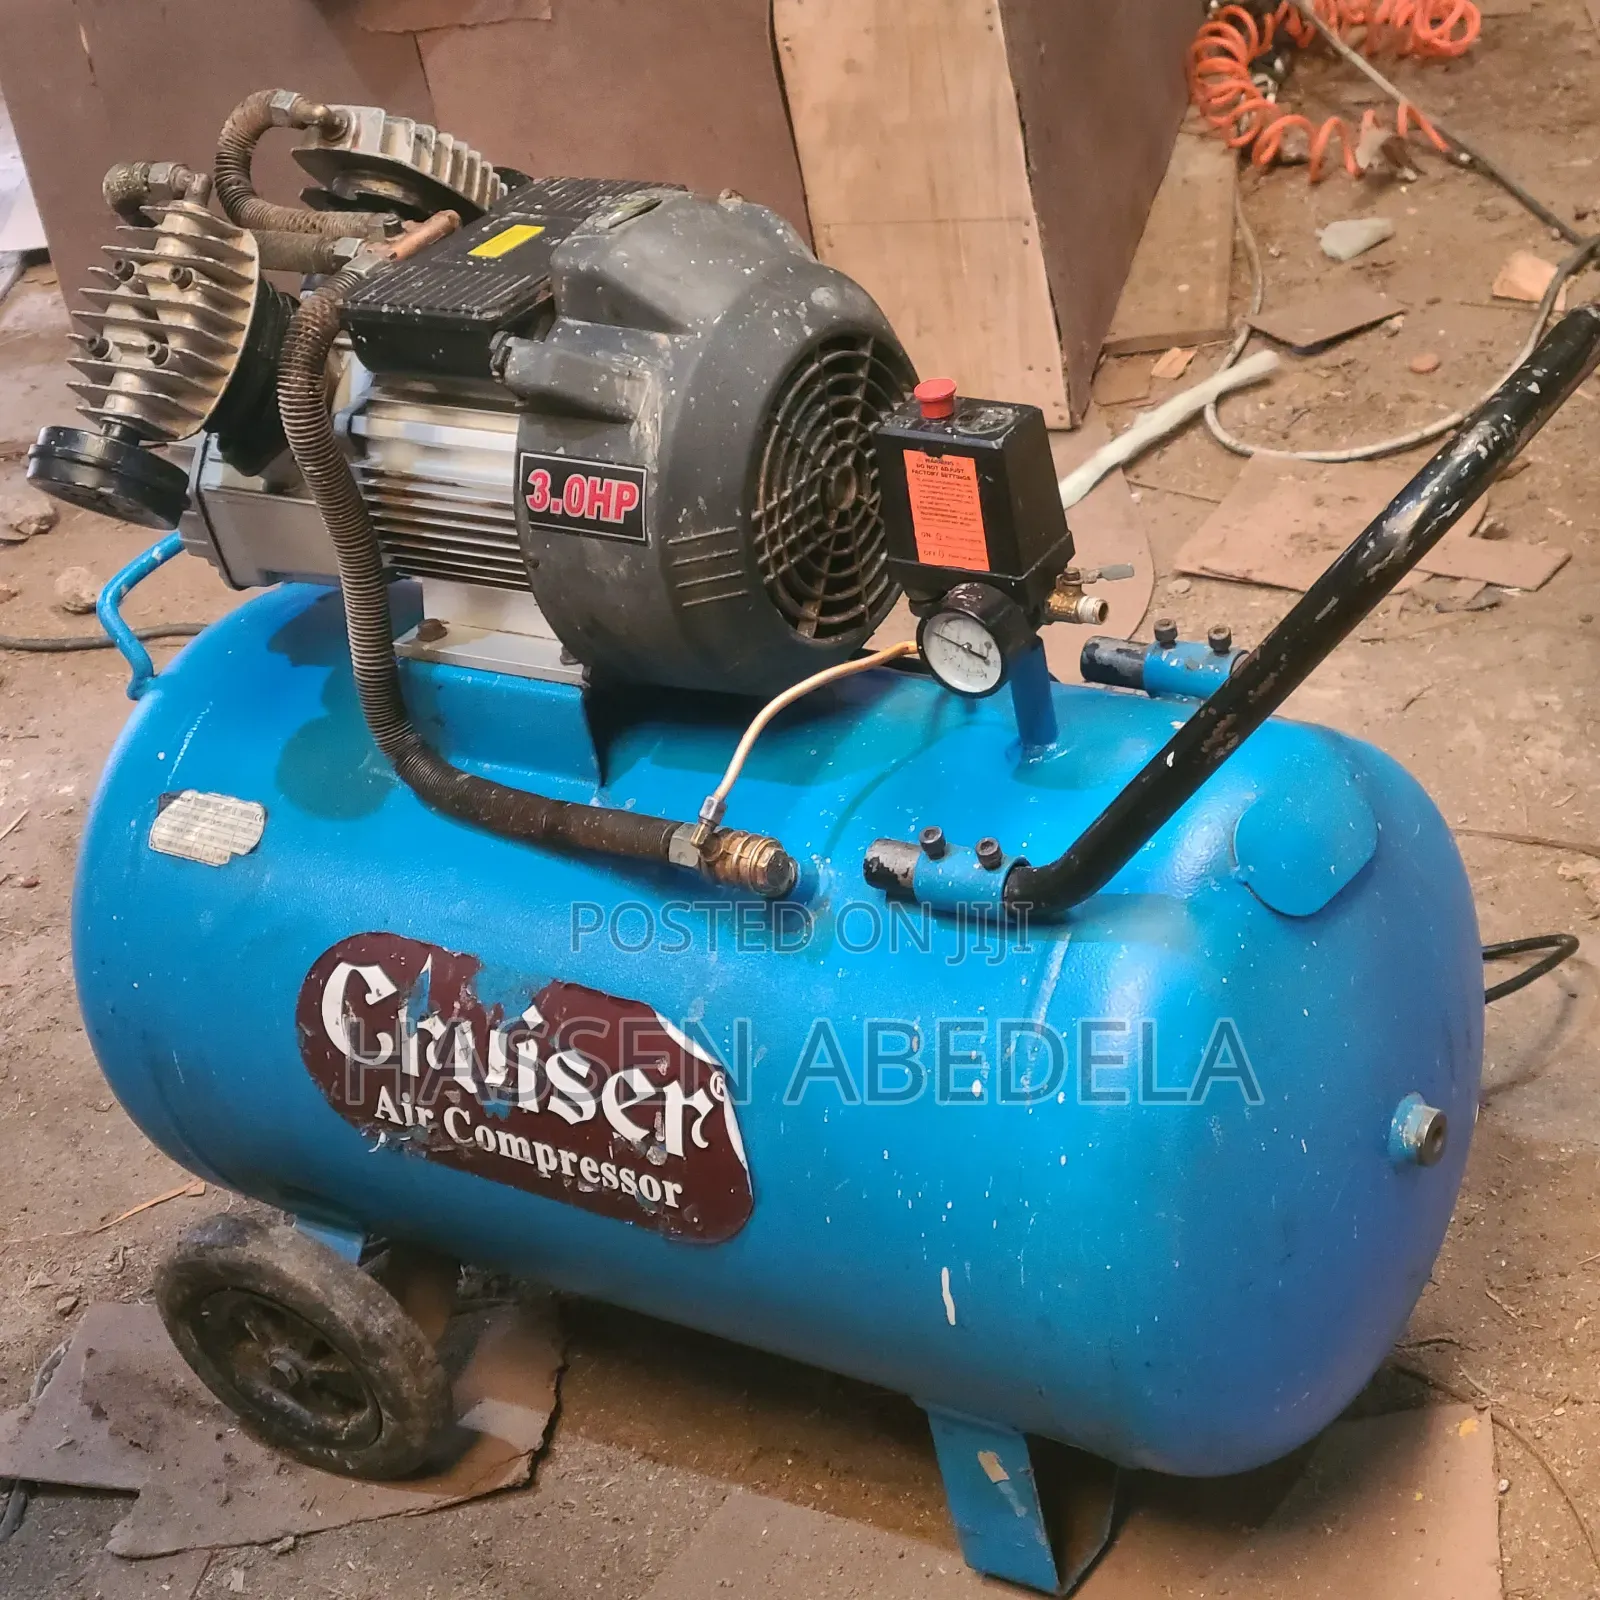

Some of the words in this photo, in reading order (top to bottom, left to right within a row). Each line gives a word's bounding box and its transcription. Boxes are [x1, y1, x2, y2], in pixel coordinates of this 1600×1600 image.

[940, 466, 965, 474] ADJUST
[940, 473, 971, 481] SETTINGS
[525, 468, 640, 524] 3.0HP
[374, 1085, 434, 1129] Air
[443, 1105, 683, 1209] Compressor
